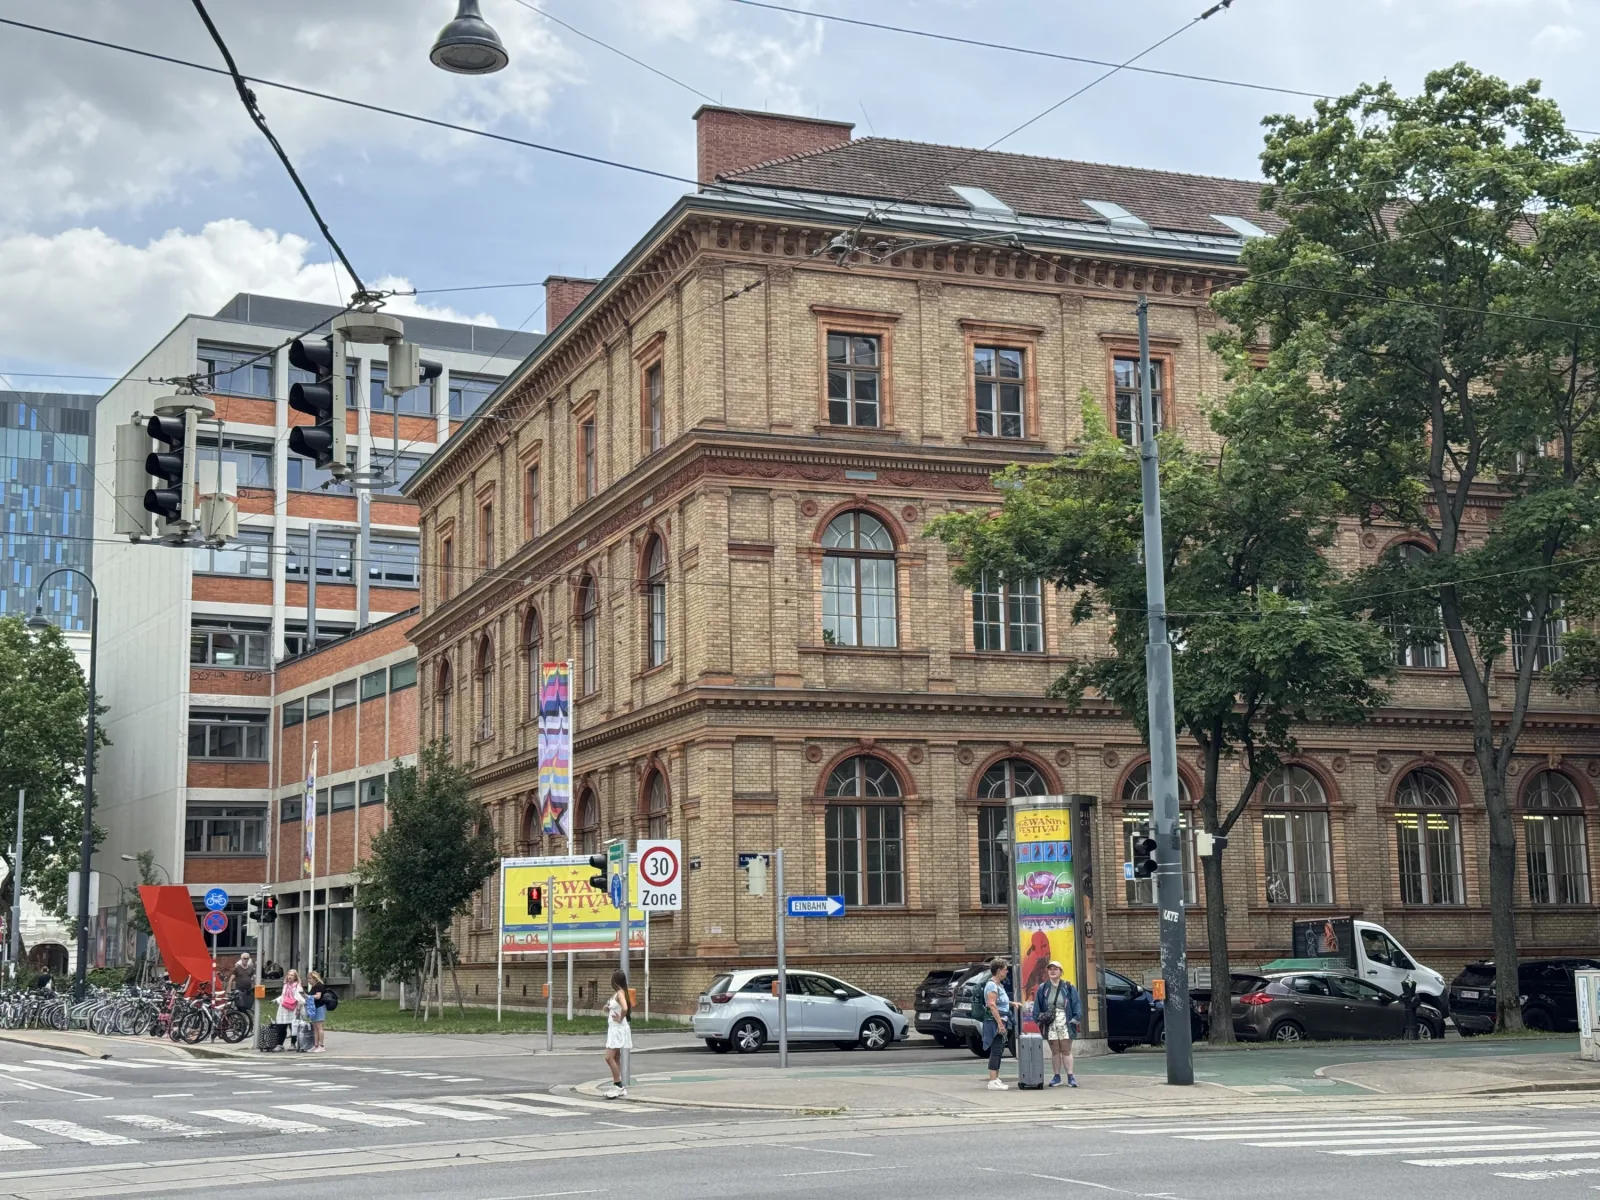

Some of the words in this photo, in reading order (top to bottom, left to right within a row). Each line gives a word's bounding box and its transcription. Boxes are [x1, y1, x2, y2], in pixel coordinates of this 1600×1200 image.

[650, 857, 669, 876] 30
[642, 889, 677, 906] Zone
[794, 902, 827, 911] EINBAHN
[504, 935, 515, 945] 01
[525, 934, 540, 945] 04
